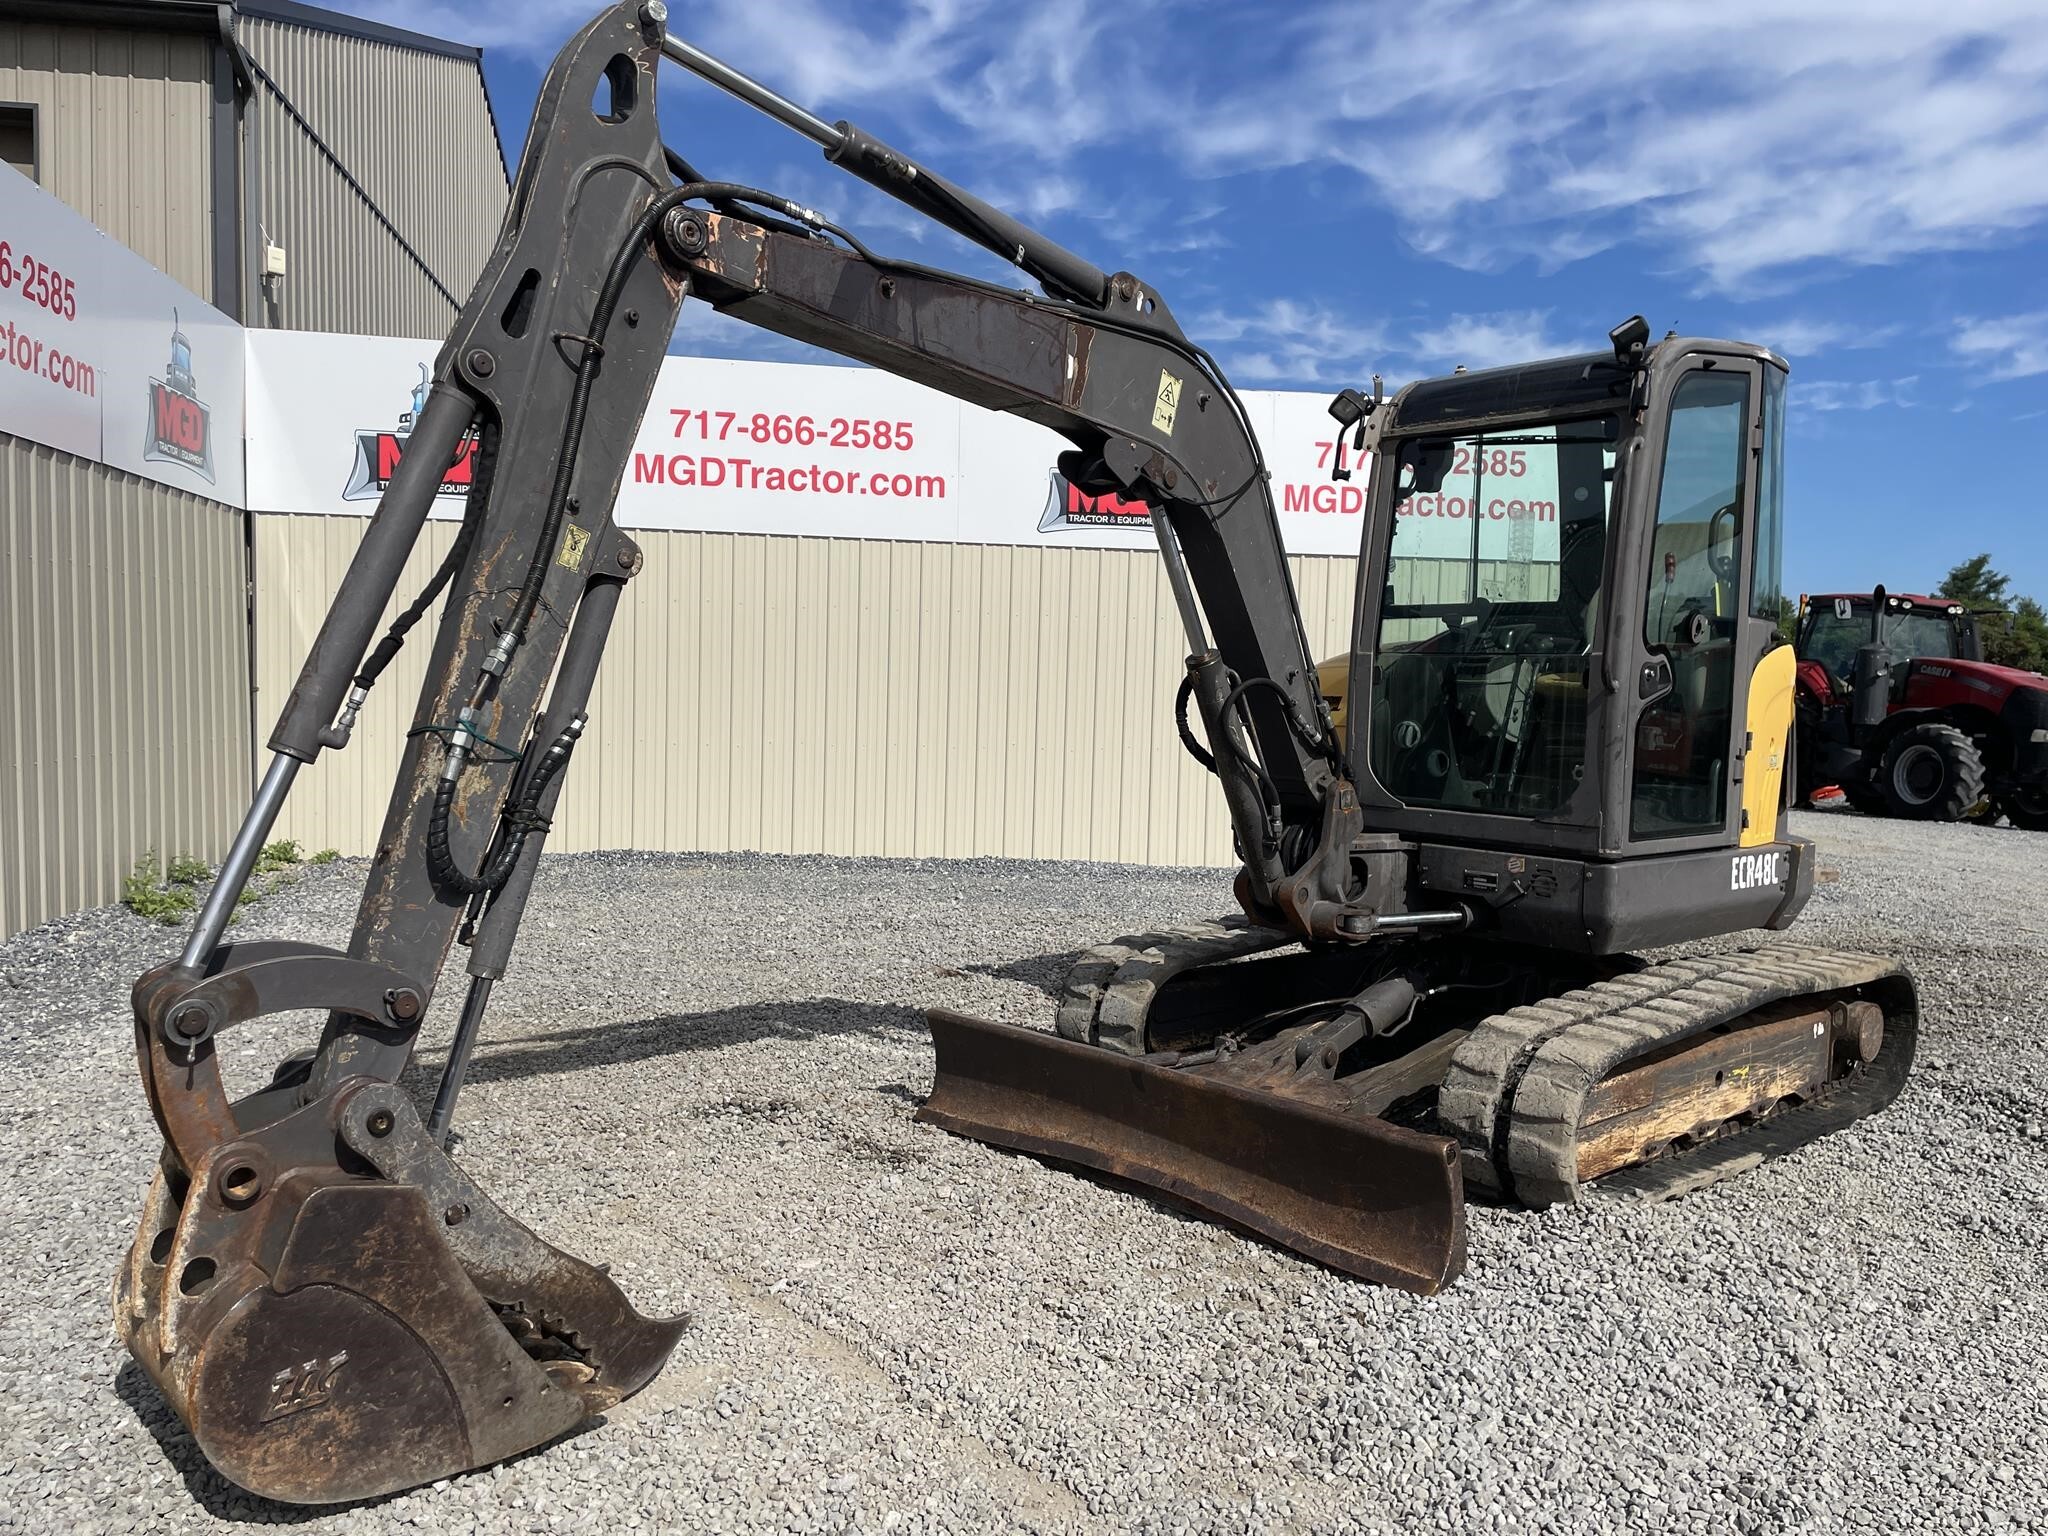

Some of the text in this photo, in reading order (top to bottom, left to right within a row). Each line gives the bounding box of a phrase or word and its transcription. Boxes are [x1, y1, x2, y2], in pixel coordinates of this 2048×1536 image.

[157, 384, 204, 453] MGD
[670, 408, 914, 451] 717-866-2585
[634, 453, 945, 498] MGDTractor.com
[1068, 514, 1109, 524] TRACTOR
[1109, 516, 1116, 524] &
[1731, 852, 1780, 890] ECR48C
